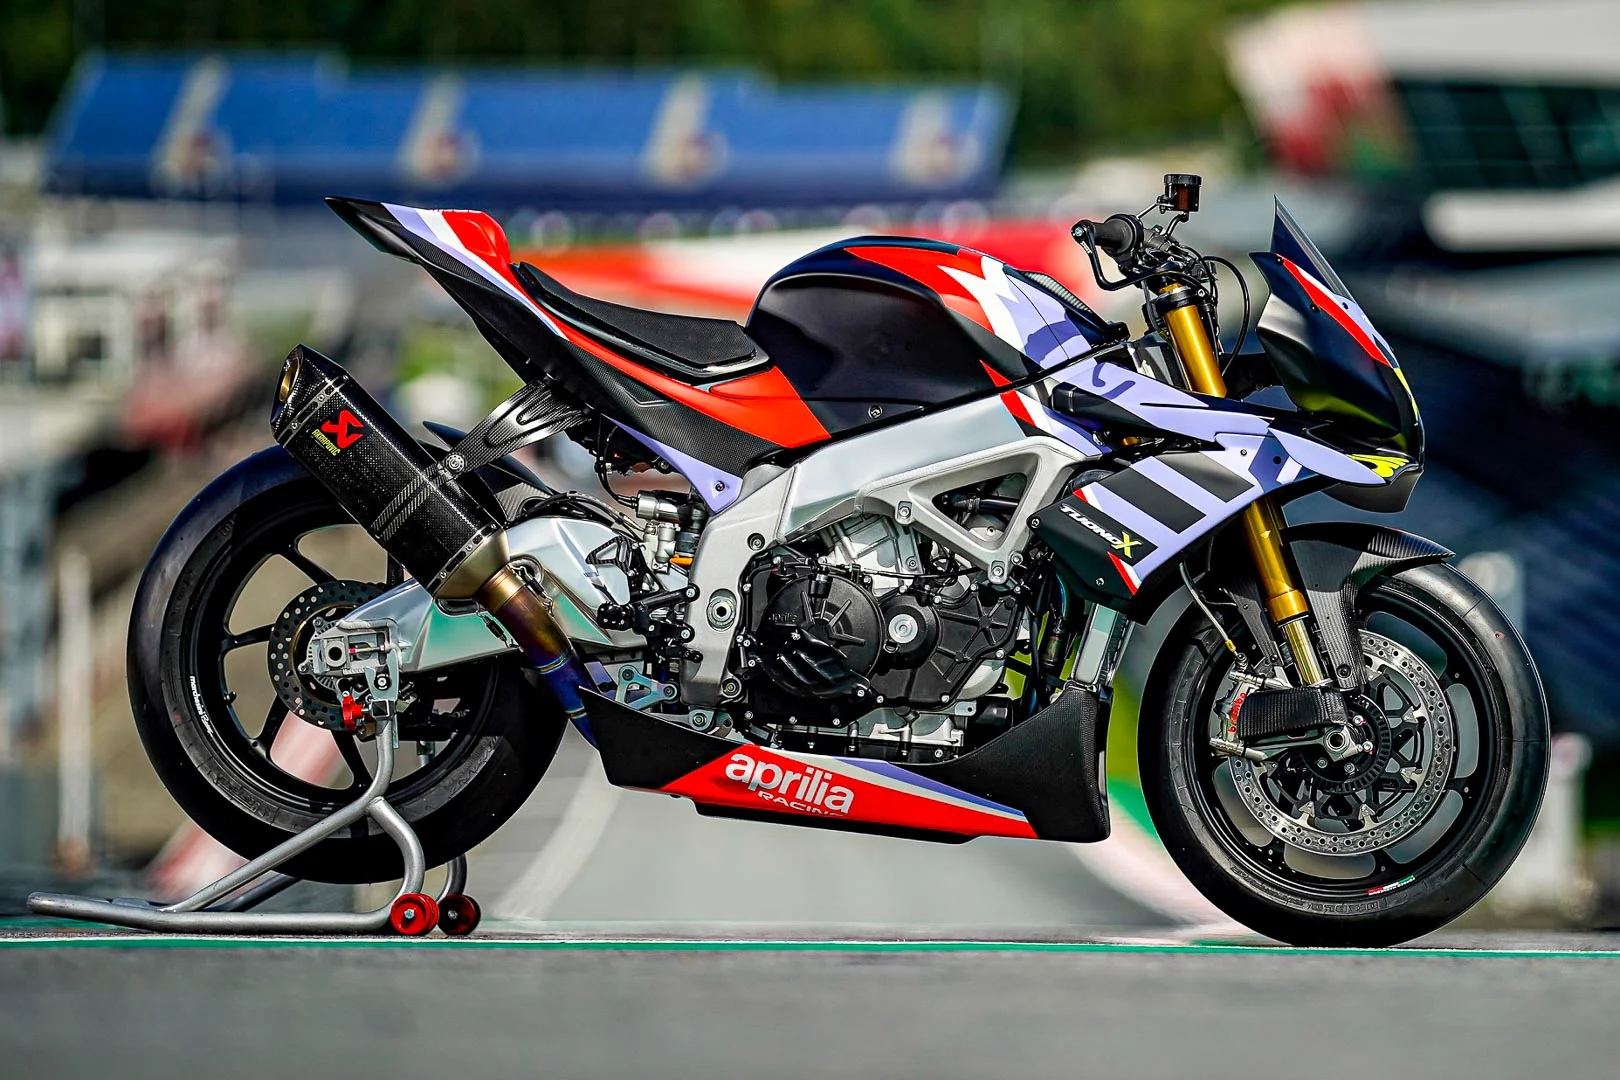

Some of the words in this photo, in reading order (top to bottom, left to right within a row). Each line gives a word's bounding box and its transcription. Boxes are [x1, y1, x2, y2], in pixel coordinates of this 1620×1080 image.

[1060, 503, 1125, 546] TUONO
[1111, 531, 1142, 559] X
[1227, 692, 1247, 733] brembo
[725, 753, 855, 814] aprilia
[757, 790, 843, 817] RACIN
